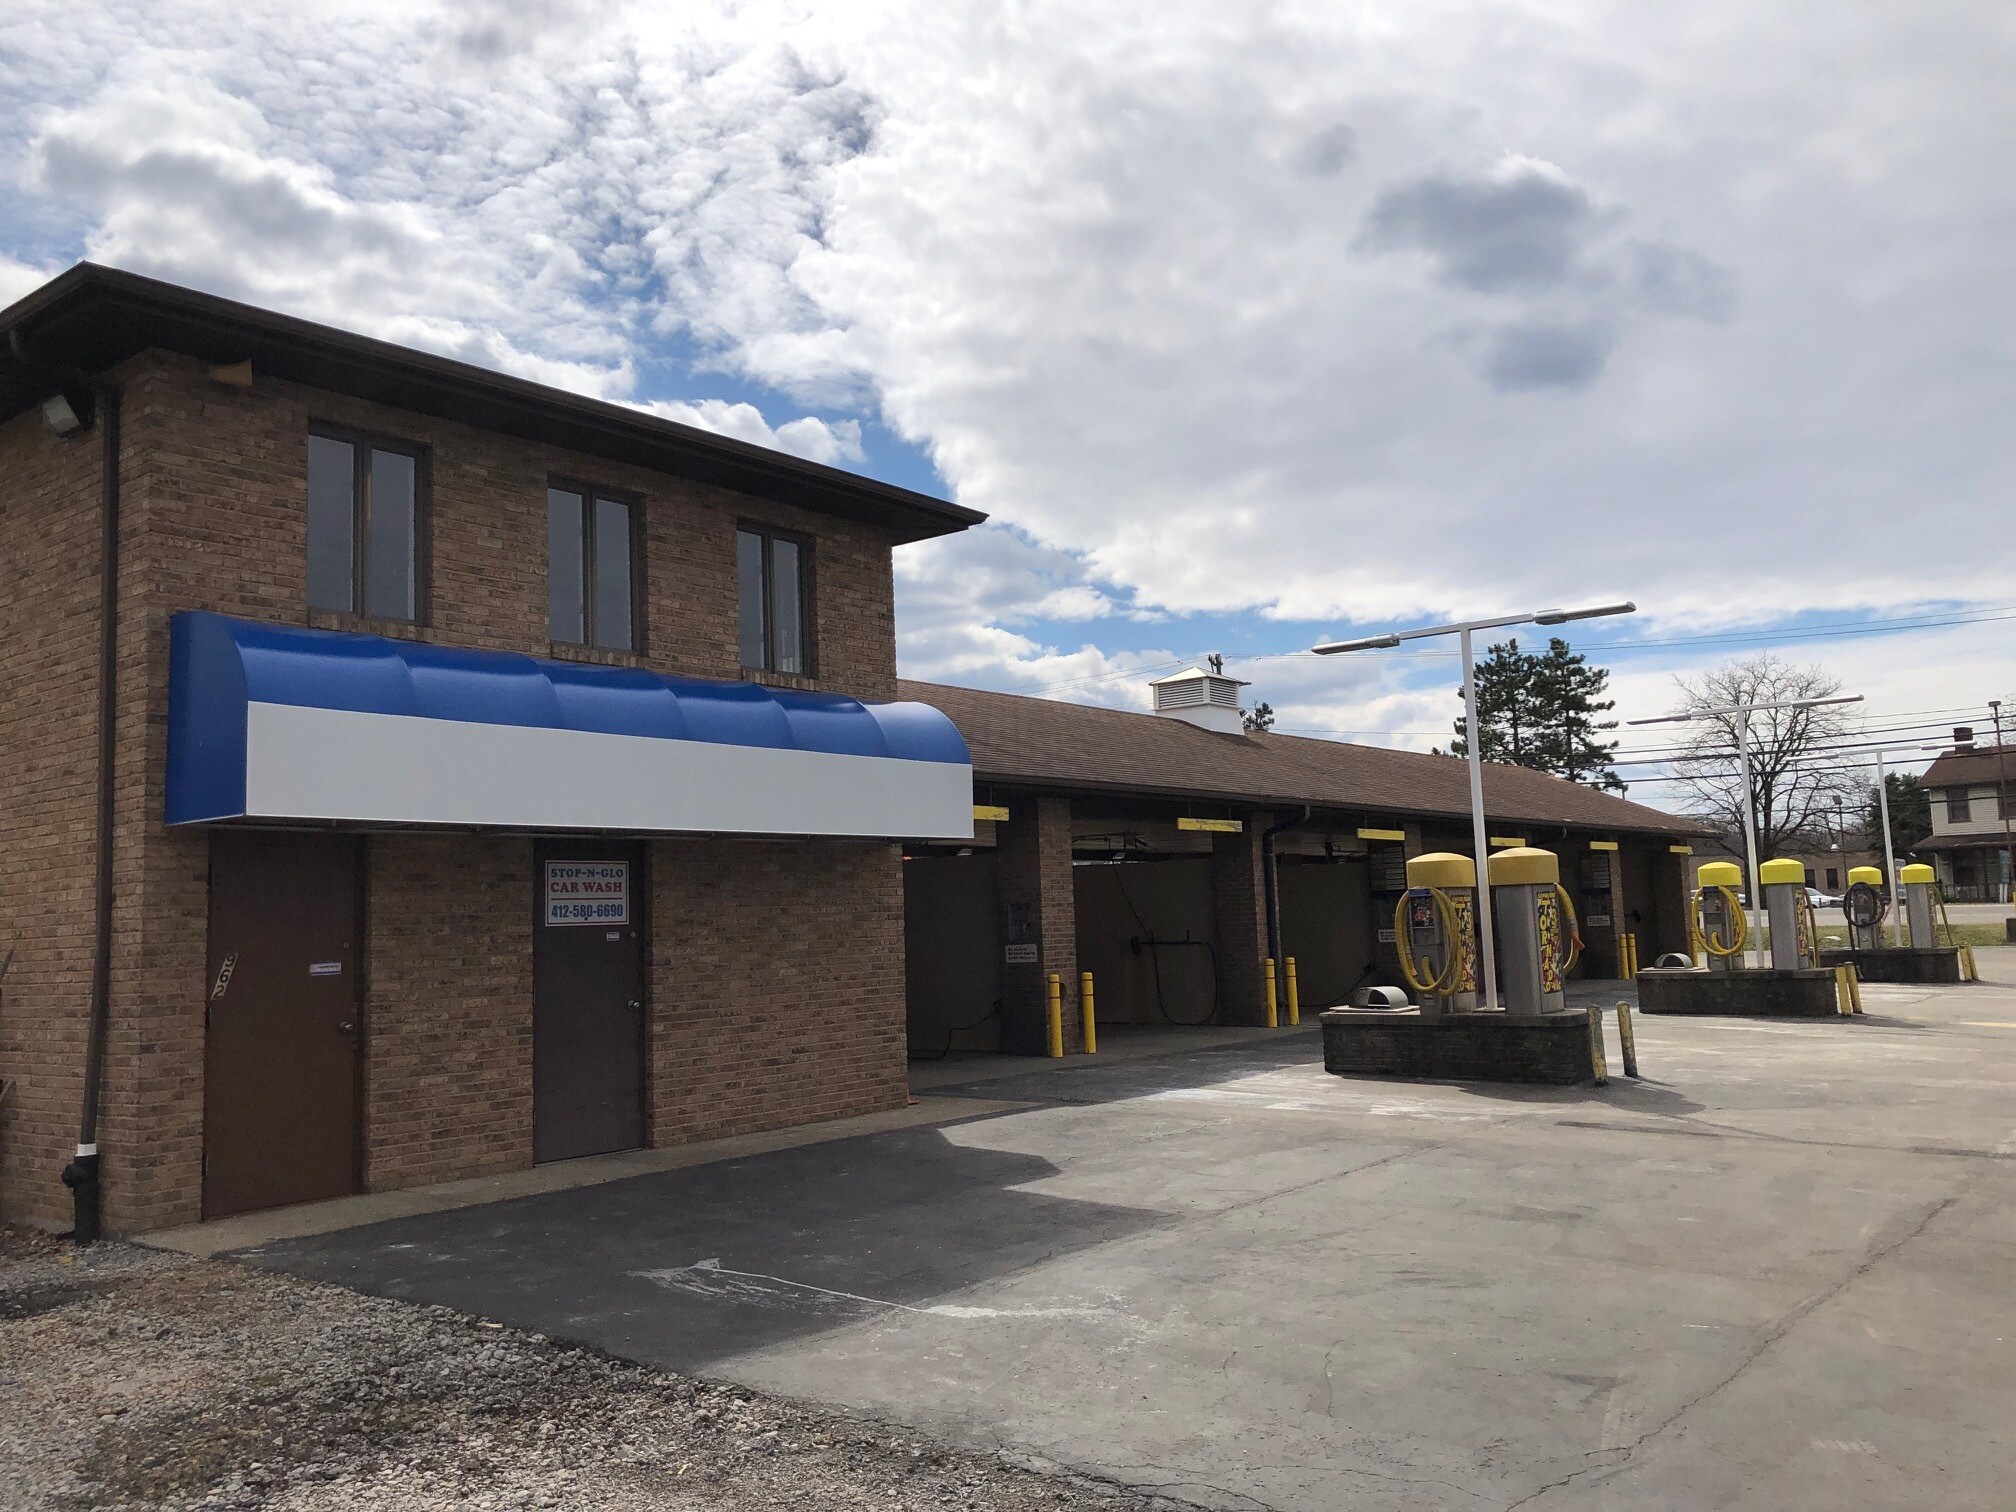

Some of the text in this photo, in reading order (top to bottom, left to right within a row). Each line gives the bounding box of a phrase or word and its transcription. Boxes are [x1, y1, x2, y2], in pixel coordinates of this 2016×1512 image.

[551, 868, 623, 878] STOP-N-GLO
[551, 882, 622, 893] CAR WASH
[551, 904, 623, 918] 412-580-6690
[213, 954, 234, 998] 962
